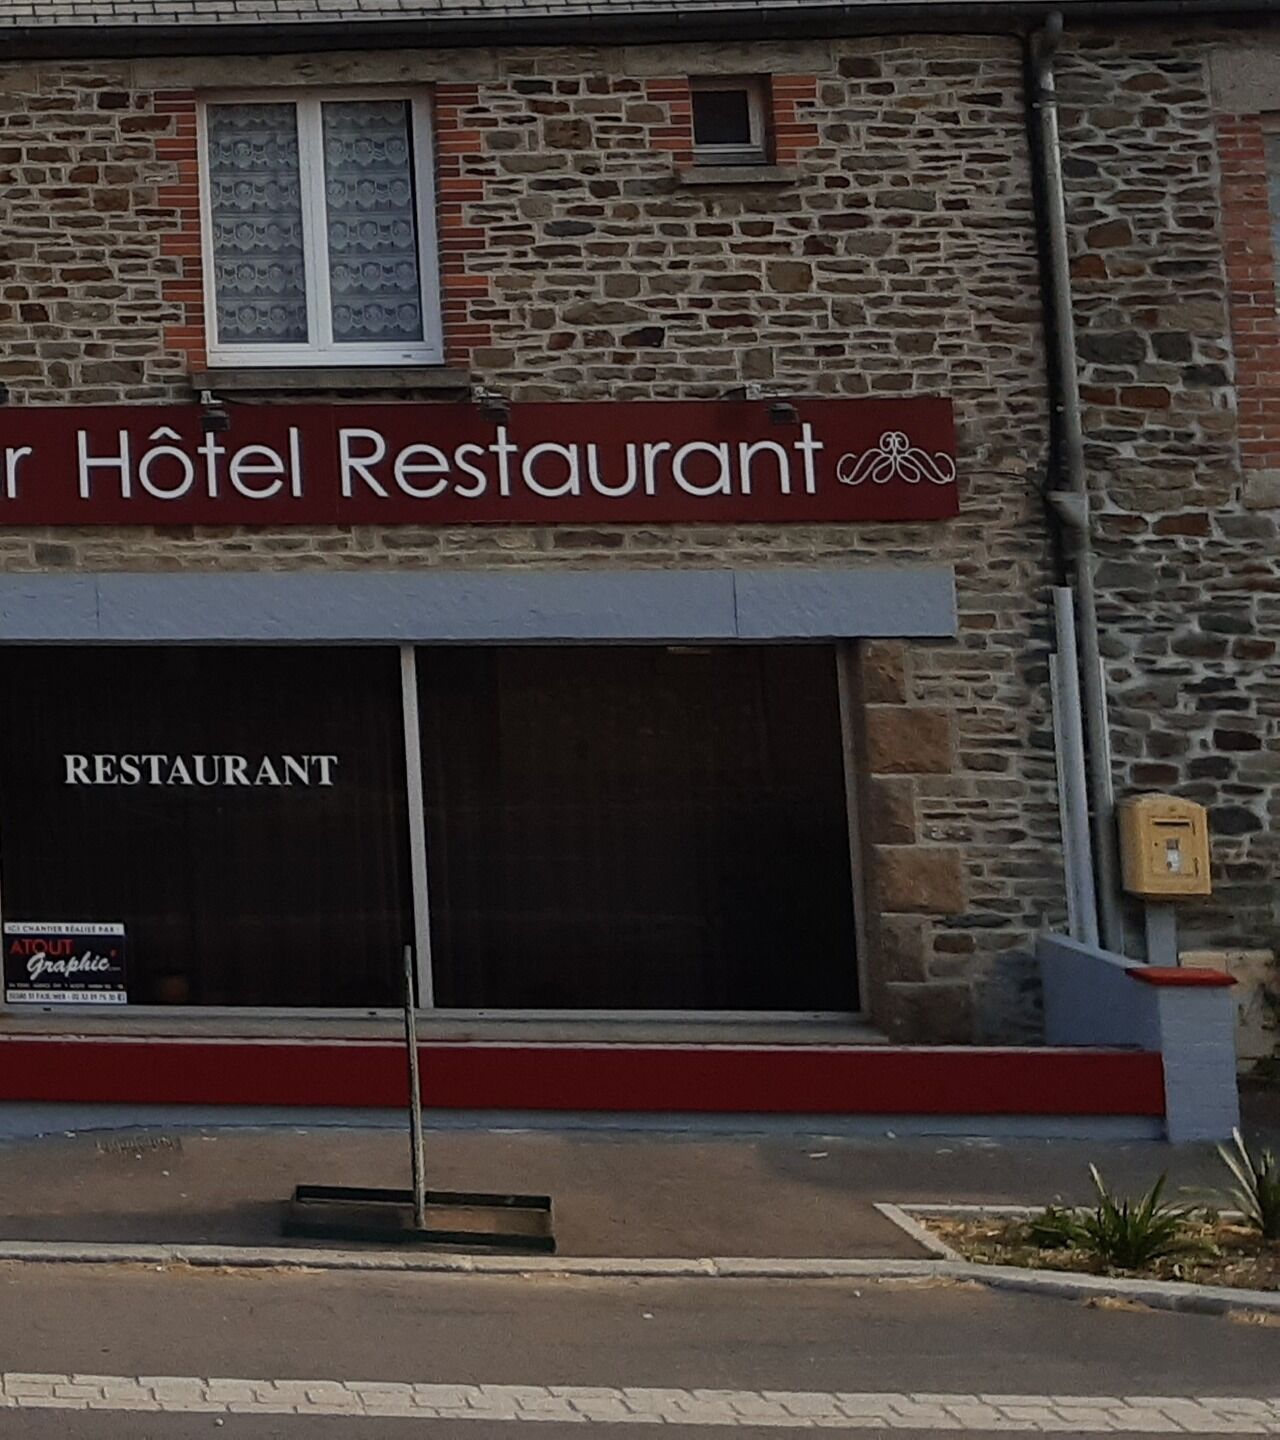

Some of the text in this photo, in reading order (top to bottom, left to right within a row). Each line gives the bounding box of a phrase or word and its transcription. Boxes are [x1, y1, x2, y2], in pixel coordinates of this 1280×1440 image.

[77, 426, 302, 499] Hôtel
[339, 423, 823, 498] Restaurant
[64, 754, 338, 786] RESTAURANT
[22, 923, 63, 933] CHANTIER
[98, 924, 115, 933] PAR
[10, 938, 74, 956] ATOUT
[26, 950, 111, 981] Graphic
